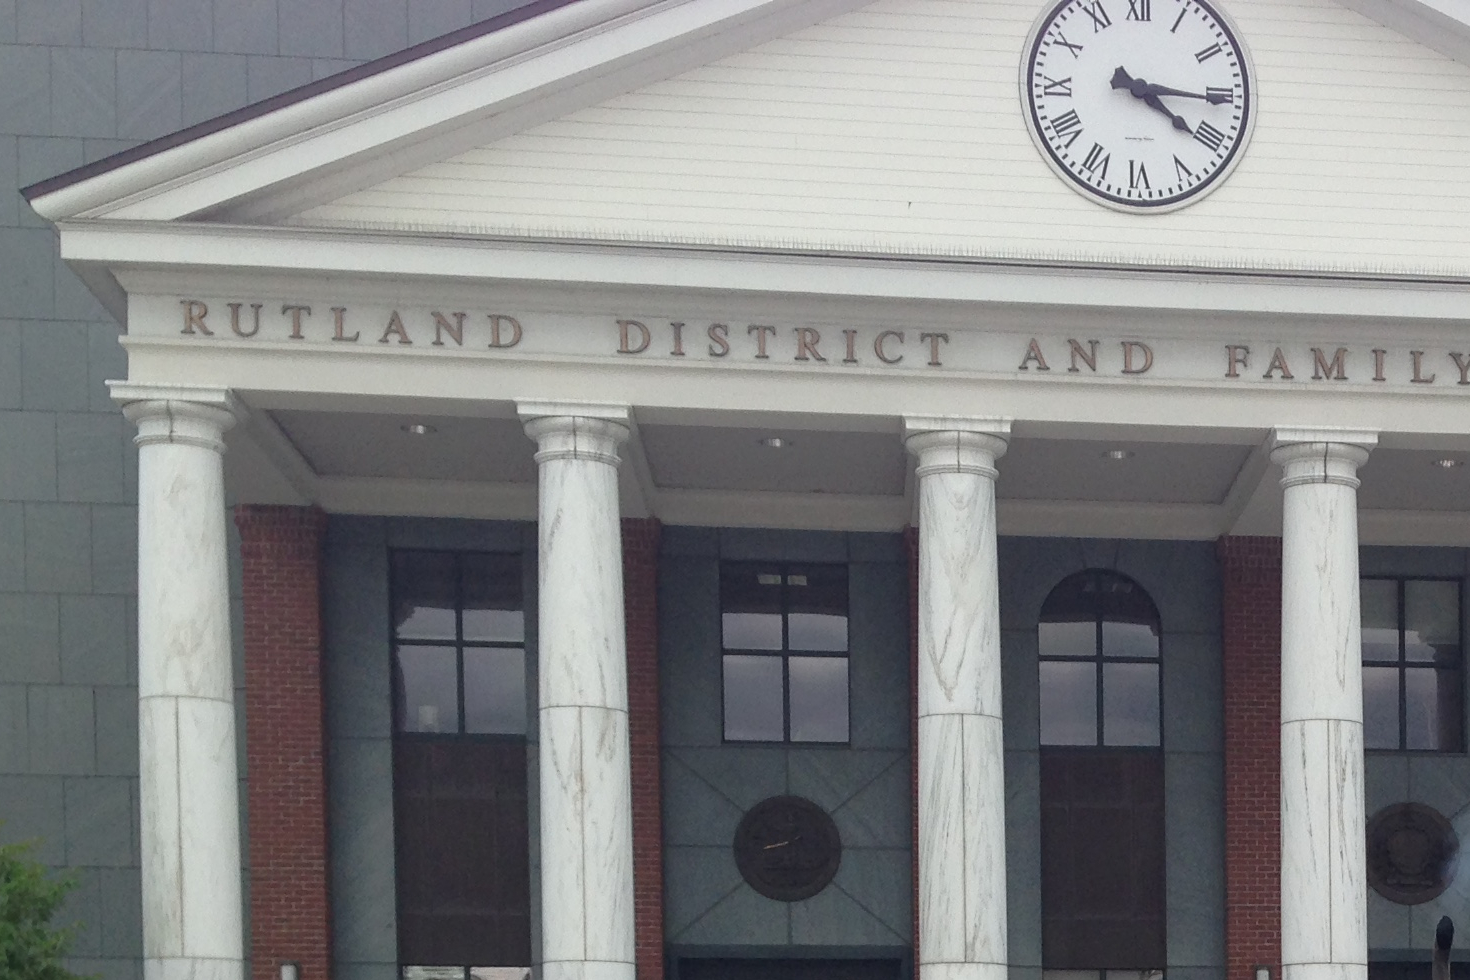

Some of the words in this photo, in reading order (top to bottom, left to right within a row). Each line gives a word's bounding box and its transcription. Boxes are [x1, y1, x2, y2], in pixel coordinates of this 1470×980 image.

[1052, 31, 1084, 59] X
[1194, 42, 1223, 64] II
[1044, 76, 1072, 97] IX
[1128, 160, 1150, 189] VI
[180, 299, 524, 349] RUTLAND
[616, 319, 950, 367] DISTRICT
[1018, 337, 1155, 375] AND
